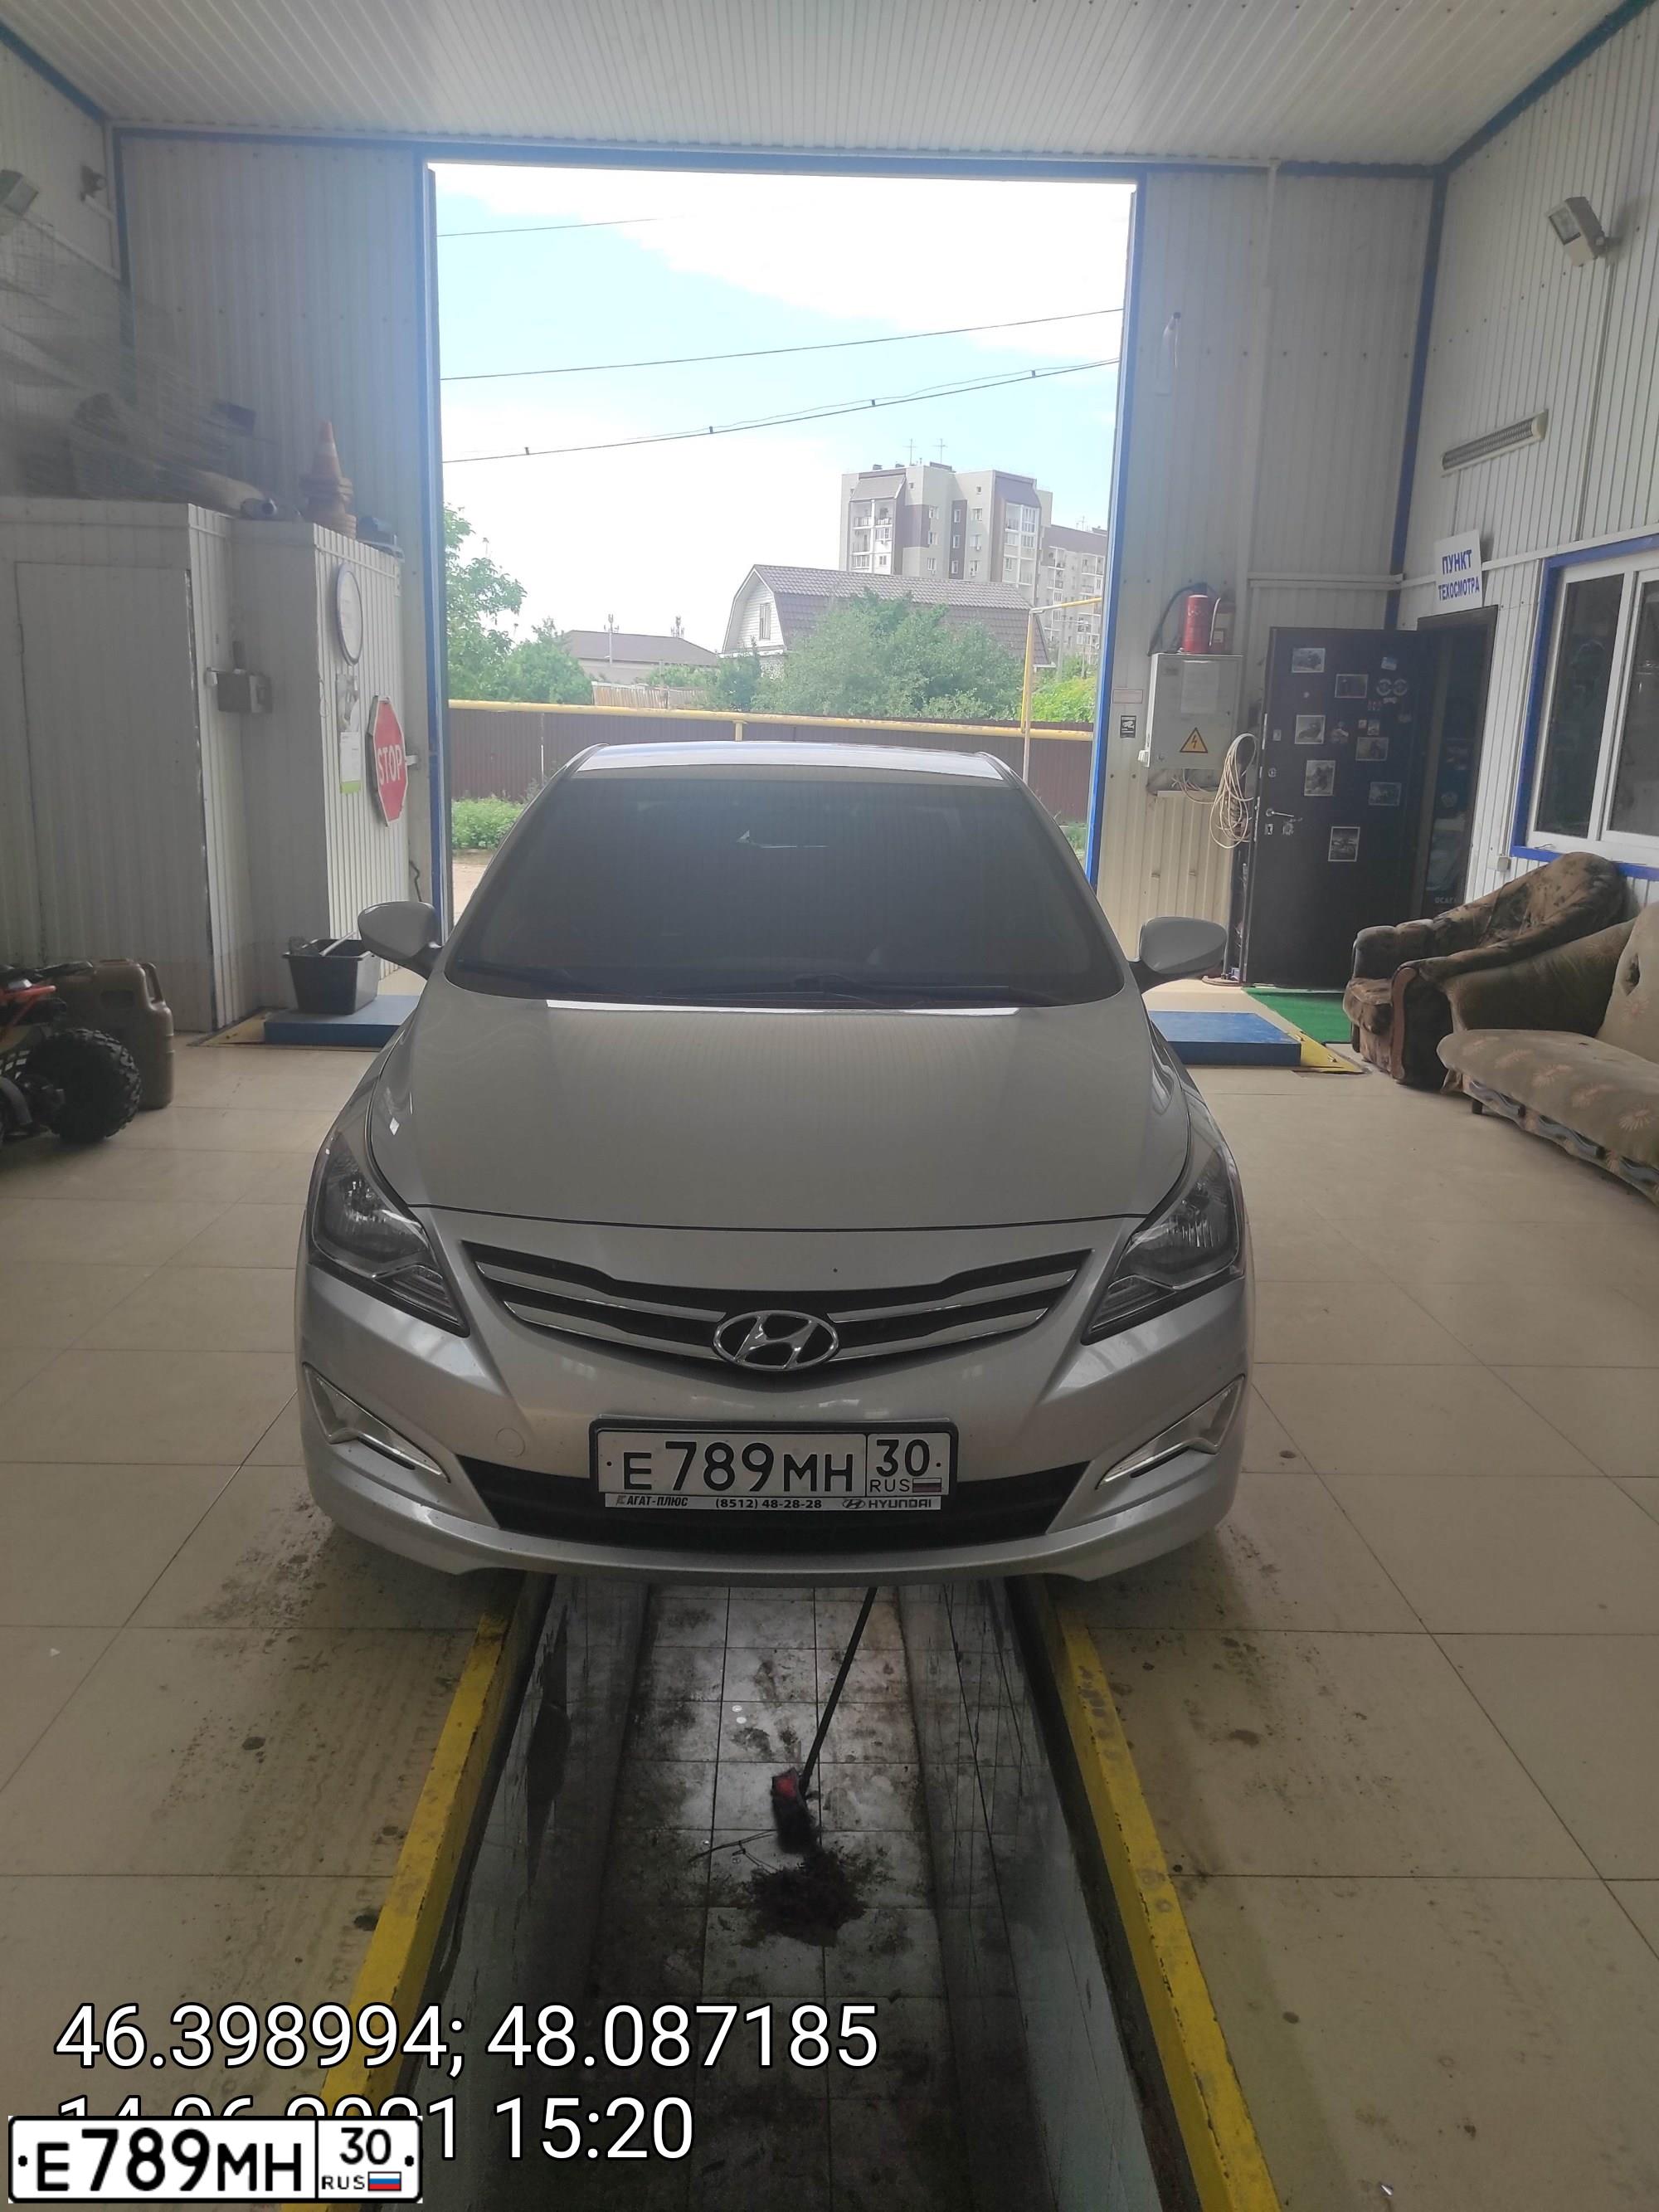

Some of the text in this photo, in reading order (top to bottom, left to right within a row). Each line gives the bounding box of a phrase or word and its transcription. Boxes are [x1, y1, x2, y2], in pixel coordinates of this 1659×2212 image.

[1442, 549, 1472, 575] ПУНКТ
[1438, 577, 1480, 601] ТЕХОСМОТРА
[377, 744, 402, 785] STOP
[875, 1439, 931, 1478] 30
[868, 1478, 911, 1493] RUS
[626, 1495, 823, 1509] АГАТ-ПЛЮС (8512) 48-28-28
[868, 1498, 932, 1508] HYUNDAI
